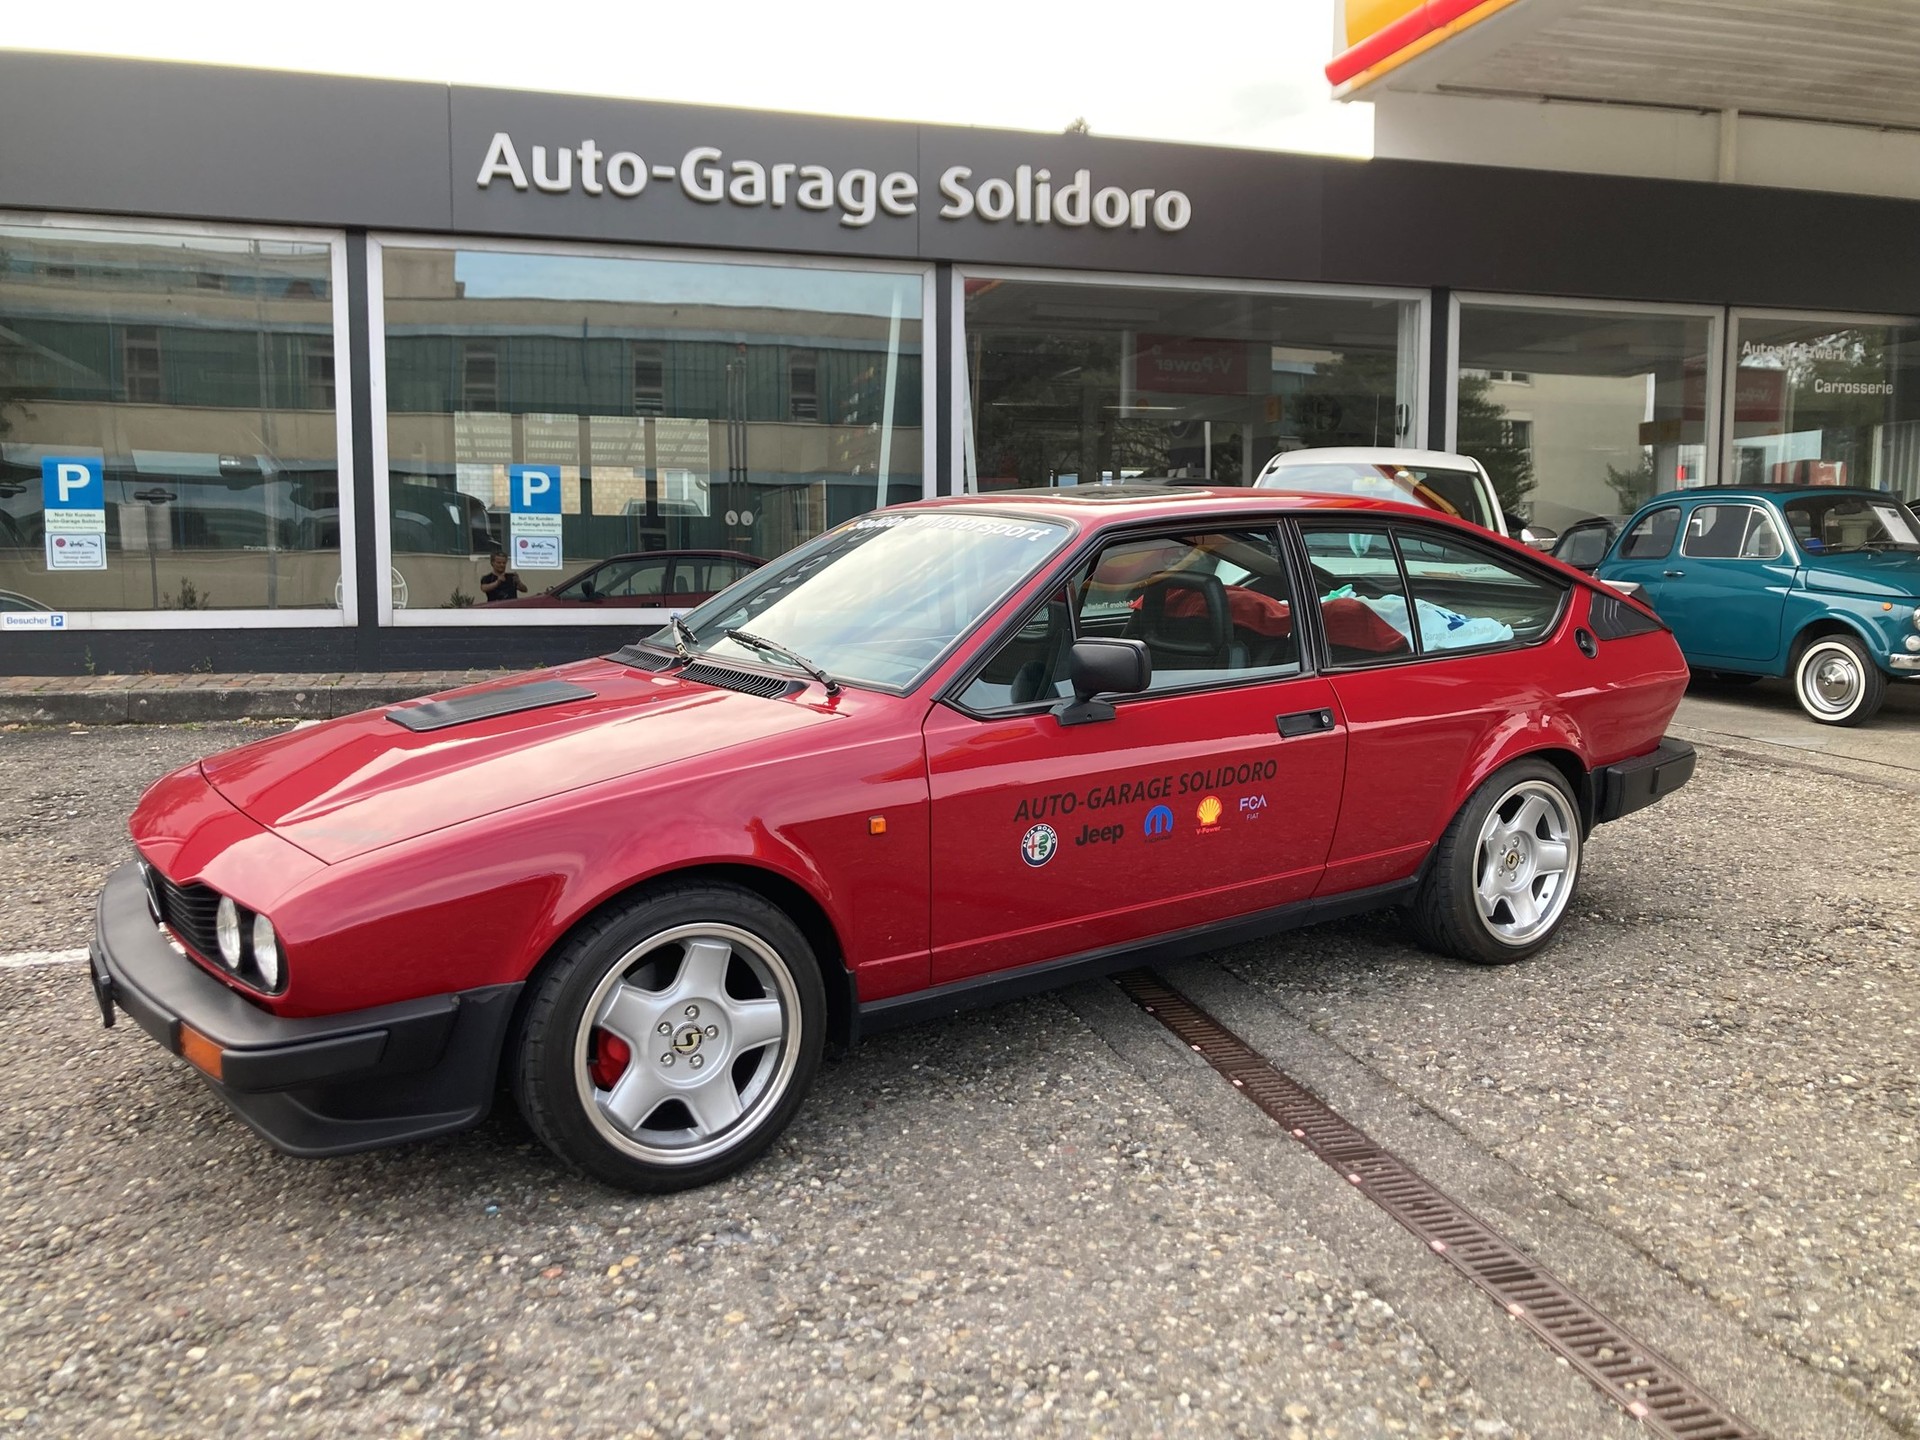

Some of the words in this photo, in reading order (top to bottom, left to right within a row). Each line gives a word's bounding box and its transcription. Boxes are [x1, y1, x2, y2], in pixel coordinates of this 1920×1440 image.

[476, 132, 919, 227] Auto-Garage
[939, 164, 1192, 231] Solidoro
[1814, 379, 1894, 395] Carrosserie
[57, 463, 91, 502] P
[522, 471, 551, 507] P
[923, 515, 1052, 542] Motorsport
[6, 616, 48, 624] Besucher
[1014, 776, 1173, 822] AUTO-GARAGE
[1178, 759, 1278, 795] SOLIDORO
[1239, 794, 1268, 812] FCA
[1075, 824, 1124, 846] Jeep
[1195, 825, 1222, 836] V-Power
